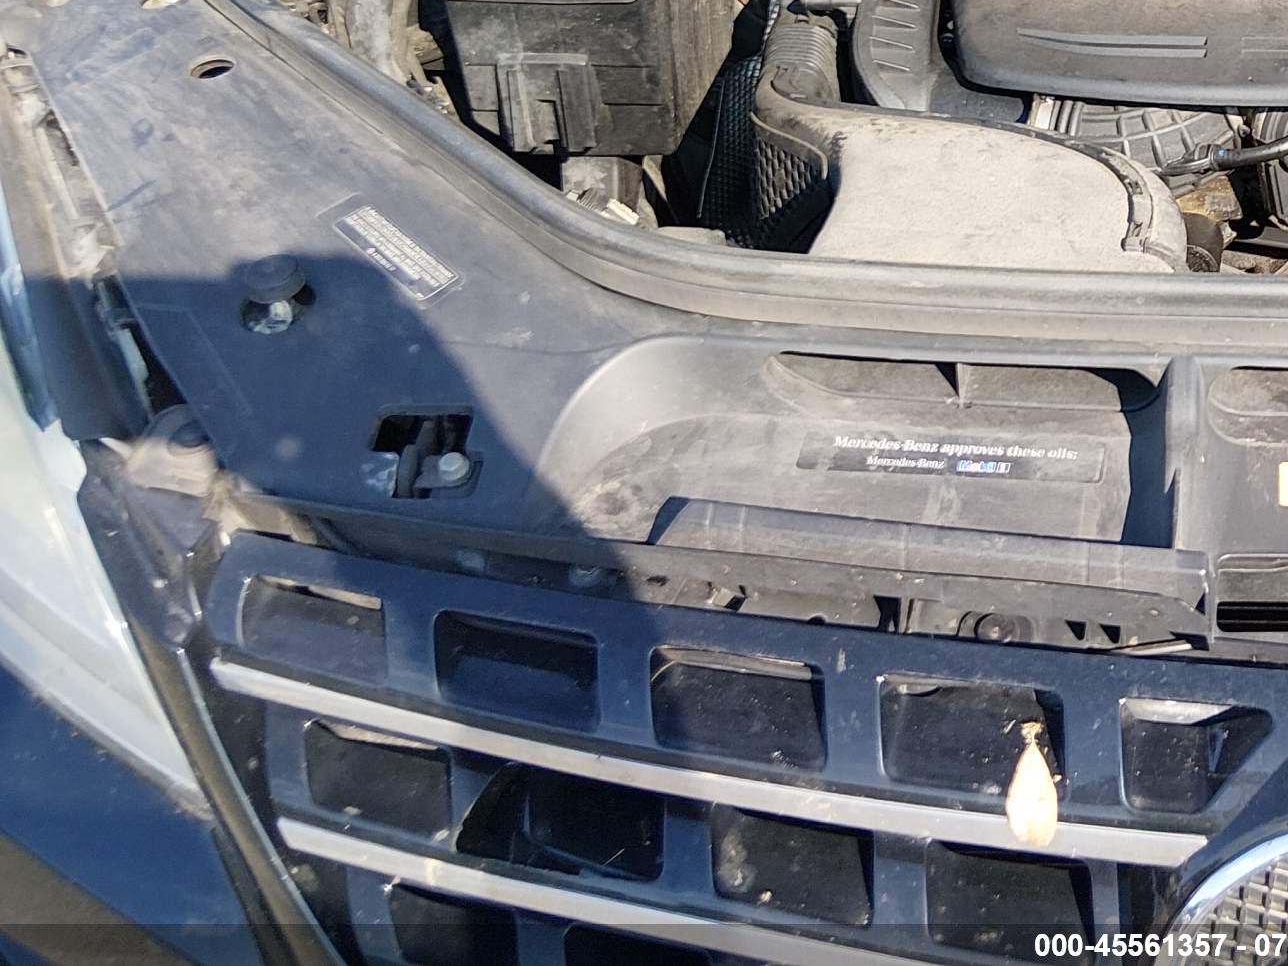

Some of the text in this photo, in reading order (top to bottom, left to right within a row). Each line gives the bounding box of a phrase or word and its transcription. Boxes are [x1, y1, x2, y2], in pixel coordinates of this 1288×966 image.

[833, 436, 939, 453] Mercedes-Benz
[940, 443, 1004, 457] approves
[1007, 445, 1045, 458] these
[866, 456, 945, 469] Mercedes-Benz
